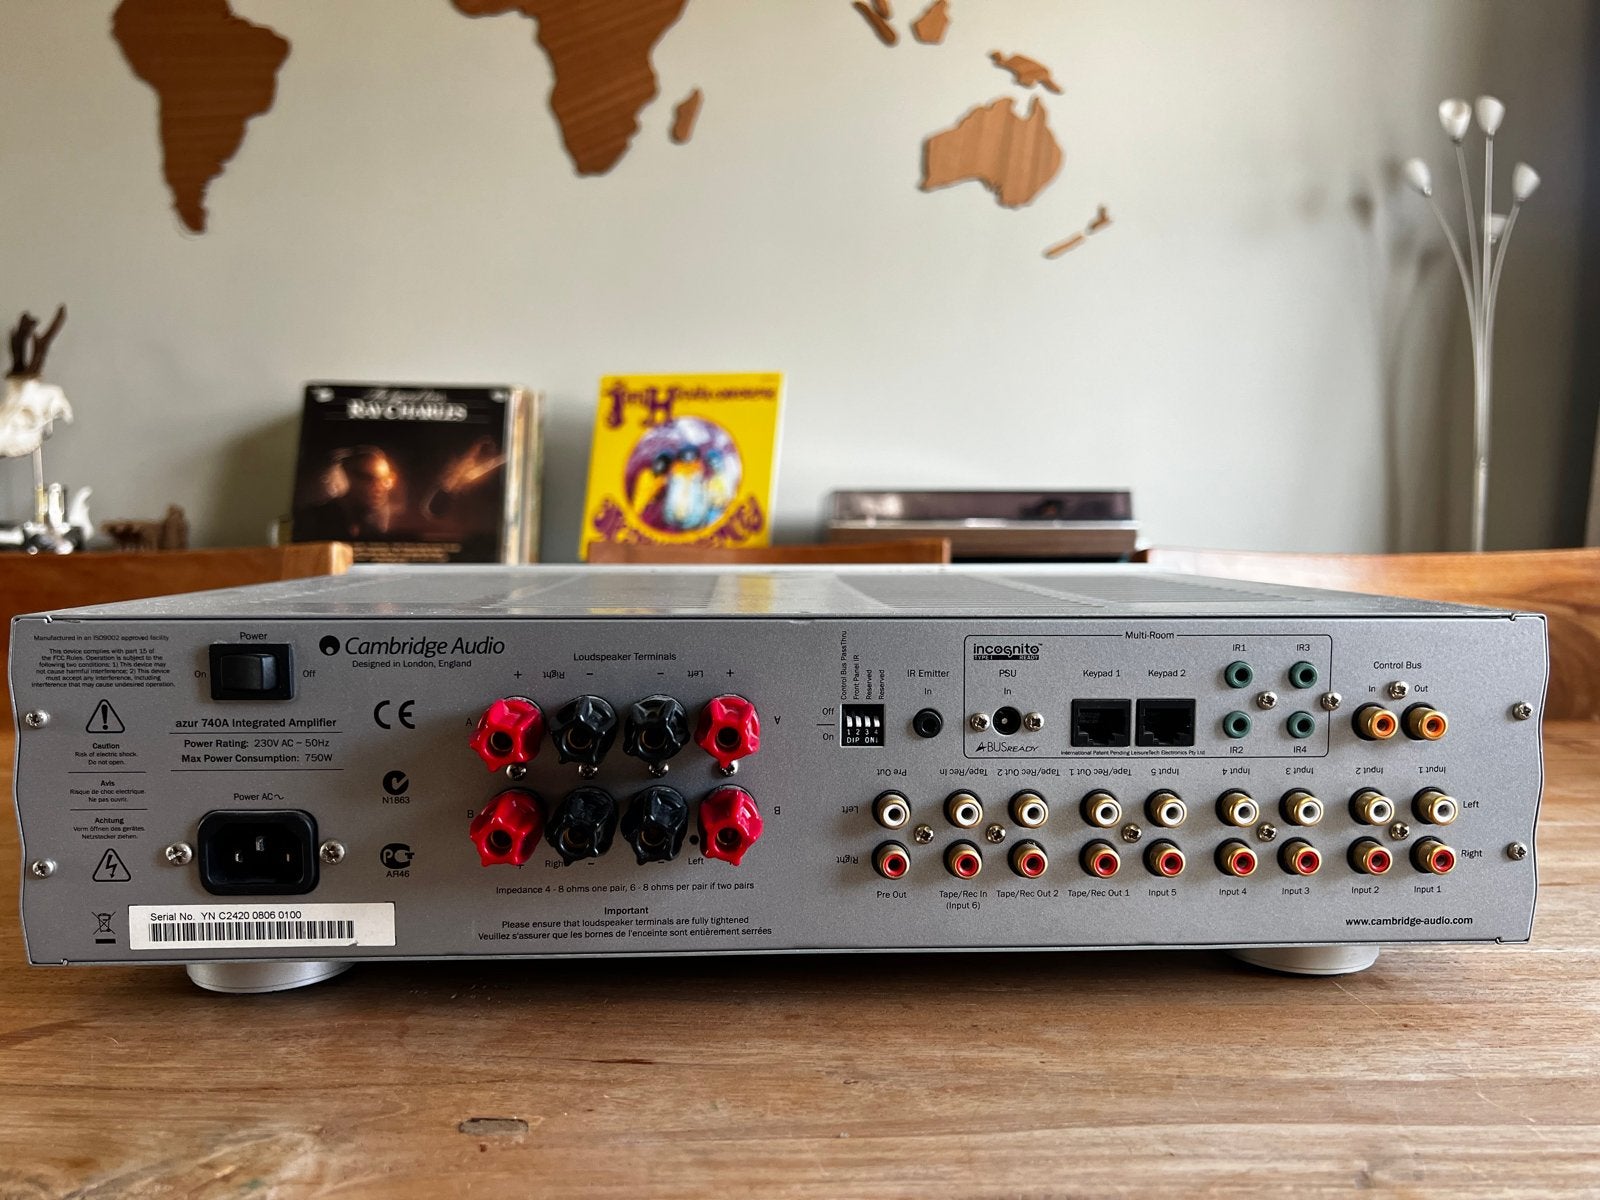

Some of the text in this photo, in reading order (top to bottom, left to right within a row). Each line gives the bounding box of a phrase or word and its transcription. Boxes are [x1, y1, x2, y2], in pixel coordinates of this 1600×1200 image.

[239, 631, 268, 641] Power
[1125, 630, 1175, 640] Multi-Room
[345, 635, 505, 658] Cambridge Audio
[1232, 643, 1247, 652] IR1
[1296, 643, 1310, 652] IR3
[573, 652, 677, 663] Loudspeaker Terminals
[352, 660, 391, 670] Designed
[403, 660, 436, 668] London,
[438, 659, 472, 669] England
[1373, 660, 1422, 670] Control Bus
[194, 670, 207, 678] On
[302, 669, 316, 678] Off
[542, 669, 565, 679] Right
[687, 670, 704, 679] Left
[907, 669, 950, 678] IR Emitter
[999, 669, 1017, 678] PSU
[1083, 669, 1120, 679] Keypad 1
[1148, 669, 1186, 679] Keypad 2
[1003, 687, 1012, 695] In
[1414, 684, 1428, 693] Out
[373, 699, 416, 730] CE
[822, 707, 835, 716] Off
[201, 718, 230, 728] 740A
[232, 718, 286, 730] Integrated
[288, 717, 337, 729] Amplifier
[465, 717, 473, 727] A
[822, 732, 834, 741] On
[184, 738, 330, 750] Power Rating: 230V AC 50Hz
[1293, 745, 1307, 753] IR4
[1229, 746, 1244, 754] IR2
[181, 753, 333, 764] Max Power Consumption: 750W
[876, 768, 907, 777] Pre Out
[939, 767, 988, 777] Tape/Rec In
[997, 767, 1061, 777] Tape/Rec Out 2
[233, 792, 273, 801] Power AC
[841, 805, 859, 814] Left
[1463, 800, 1479, 809] Left
[467, 809, 474, 819] B
[94, 817, 125, 825] Achtung
[1461, 849, 1483, 859] Right
[544, 859, 564, 870] Righ
[687, 856, 704, 865] Left
[836, 854, 859, 865] Right
[496, 886, 543, 895] Impedance
[566, 884, 590, 893] ohms
[609, 884, 628, 893] pair,
[630, 883, 636, 891] 6
[642, 883, 649, 891] 8
[650, 883, 674, 891] ohms
[676, 883, 690, 892] per
[691, 882, 708, 891] pair
[709, 881, 715, 890] if
[734, 882, 754, 890] pairs
[1148, 888, 1177, 898] Input 5
[1219, 888, 1240, 897] Input
[1281, 886, 1310, 896] Input 3
[1351, 885, 1380, 895] Input 2
[1414, 885, 1441, 894] Input 1
[876, 890, 907, 899] Pre Out
[939, 890, 978, 900] Tape/Rec
[996, 889, 1059, 899] Tape/Rec Out 2
[1067, 889, 1130, 899] Tape/Rec Out 1
[604, 906, 649, 916] Important
[946, 901, 981, 911] (Input 6)
[150, 910, 302, 922] Serial No. YN C2420 0806 0100
[501, 920, 530, 929] Please
[563, 919, 581, 928] that
[582, 918, 634, 928] loudspeaker
[635, 917, 674, 926] terminals
[691, 916, 709, 926] fully
[710, 916, 749, 926] tightened
[1345, 916, 1473, 927] www.cambridge-audio.com
[478, 926, 772, 941] Veuillez s'assurer que les bornes de l'enceinte sont entièrement serrées
